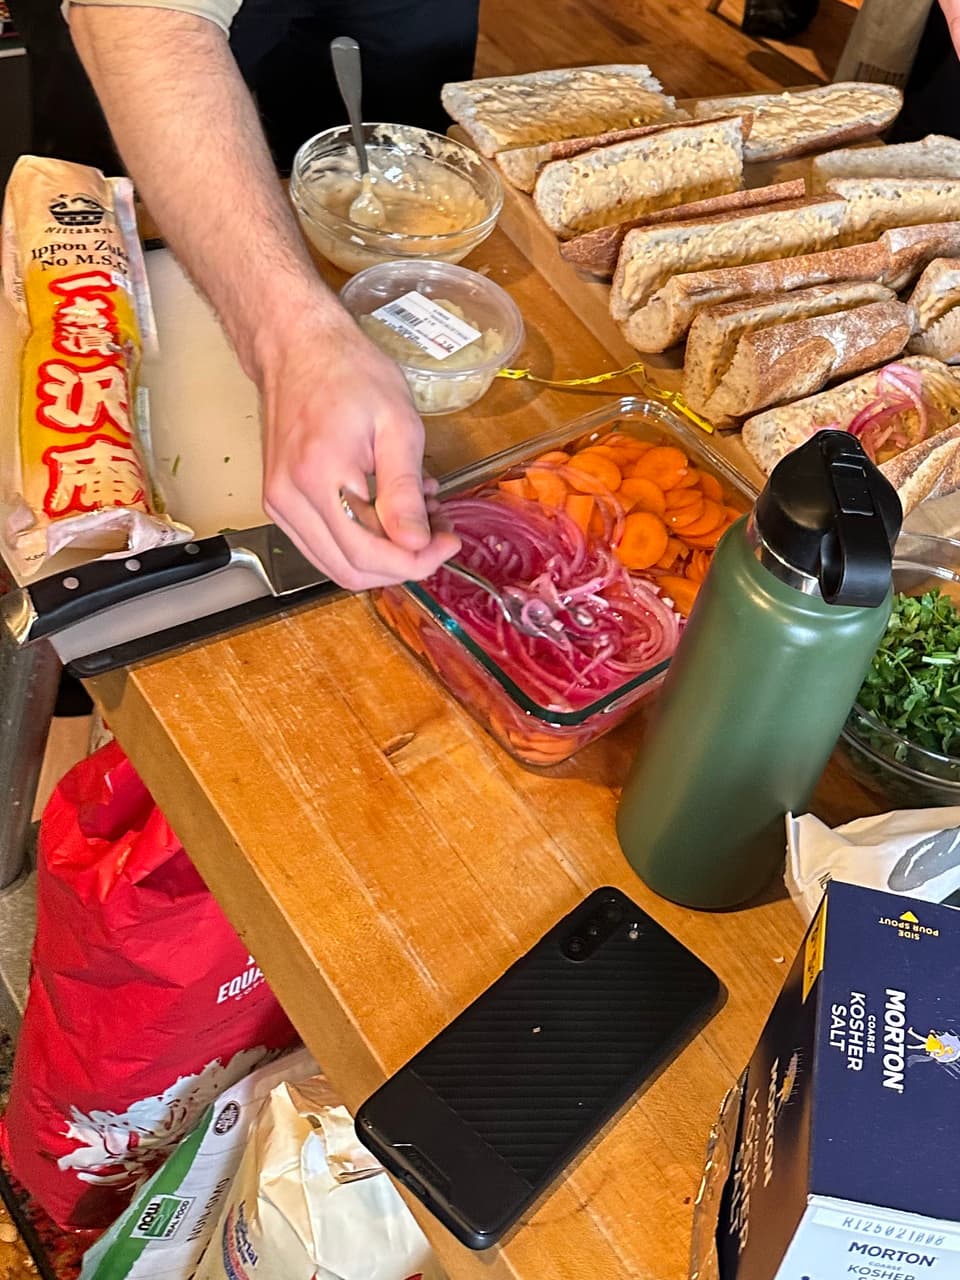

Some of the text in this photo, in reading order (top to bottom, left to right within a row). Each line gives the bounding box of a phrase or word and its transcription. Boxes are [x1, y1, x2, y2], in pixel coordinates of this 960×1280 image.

[31, 242, 88, 260] Ippon
[41, 256, 69, 271] No
[878, 916, 939, 937] POUR SPOUT
[897, 929, 920, 941] SIDE
[216, 967, 264, 1005] EQUA
[829, 1003, 847, 1052] SALT
[847, 991, 866, 1072] KOSHER
[867, 1014, 876, 1054] COARSE
[882, 988, 906, 1091] MORTON
[764, 1056, 779, 1188] MORTON
[738, 1088, 760, 1256] KOSHER
[137, 1202, 161, 1232] now
[175, 1199, 190, 1223] FOOD
[848, 1241, 936, 1267] MORTON
[867, 1261, 903, 1271] COARSE
